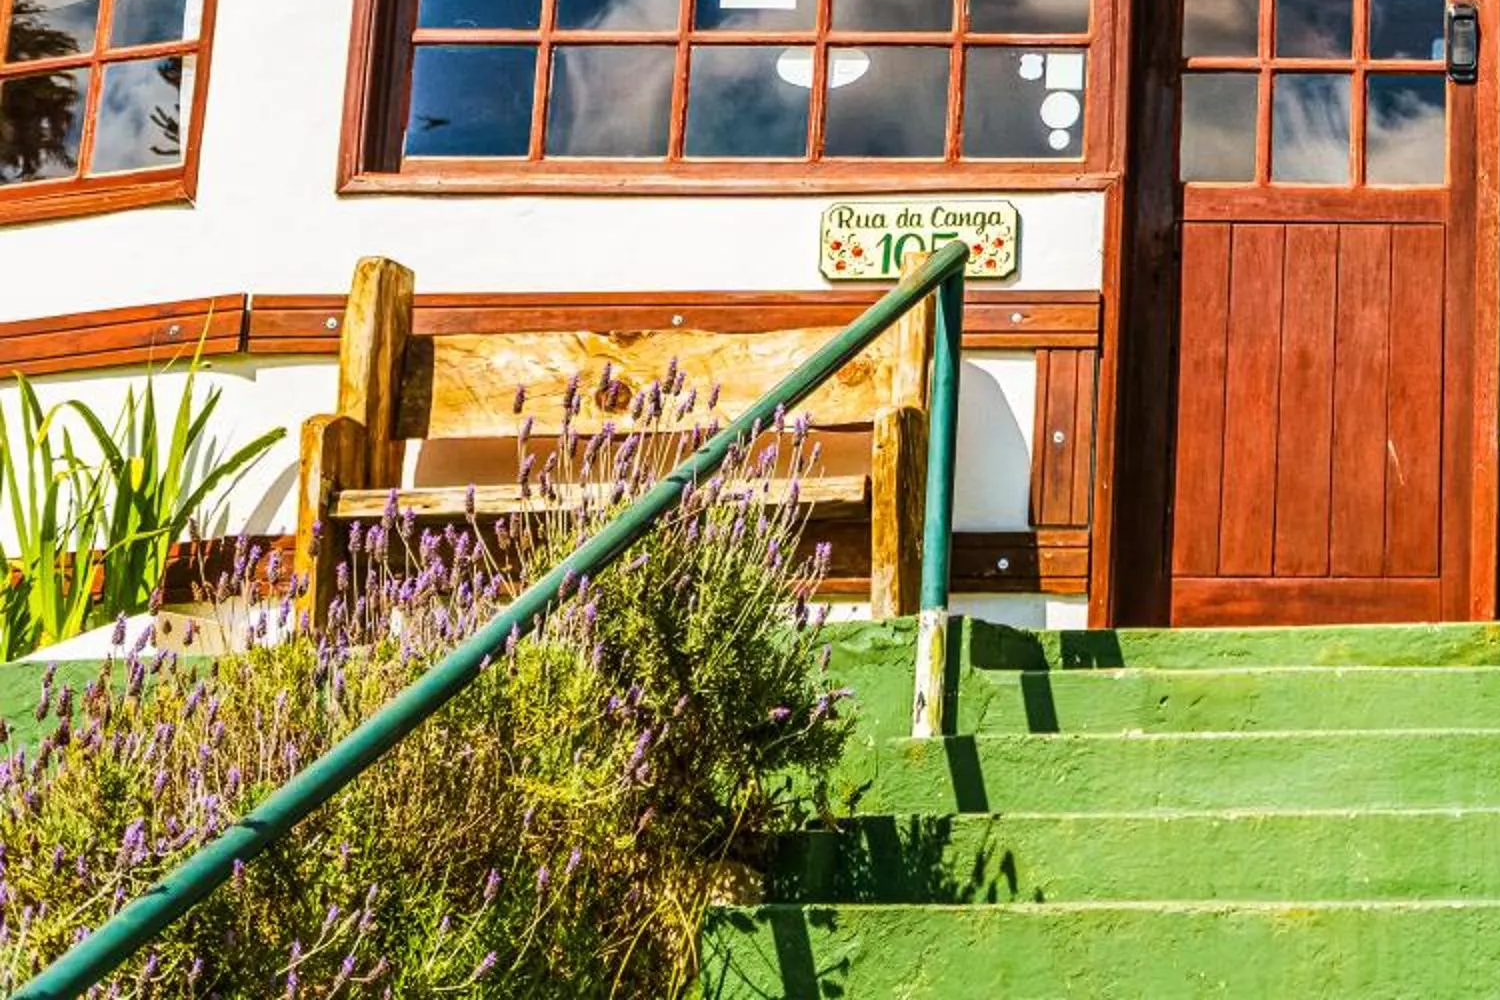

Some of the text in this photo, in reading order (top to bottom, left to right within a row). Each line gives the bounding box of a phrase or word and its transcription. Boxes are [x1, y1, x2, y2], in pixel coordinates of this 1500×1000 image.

[829, 205, 1004, 236] Rua da Canga
